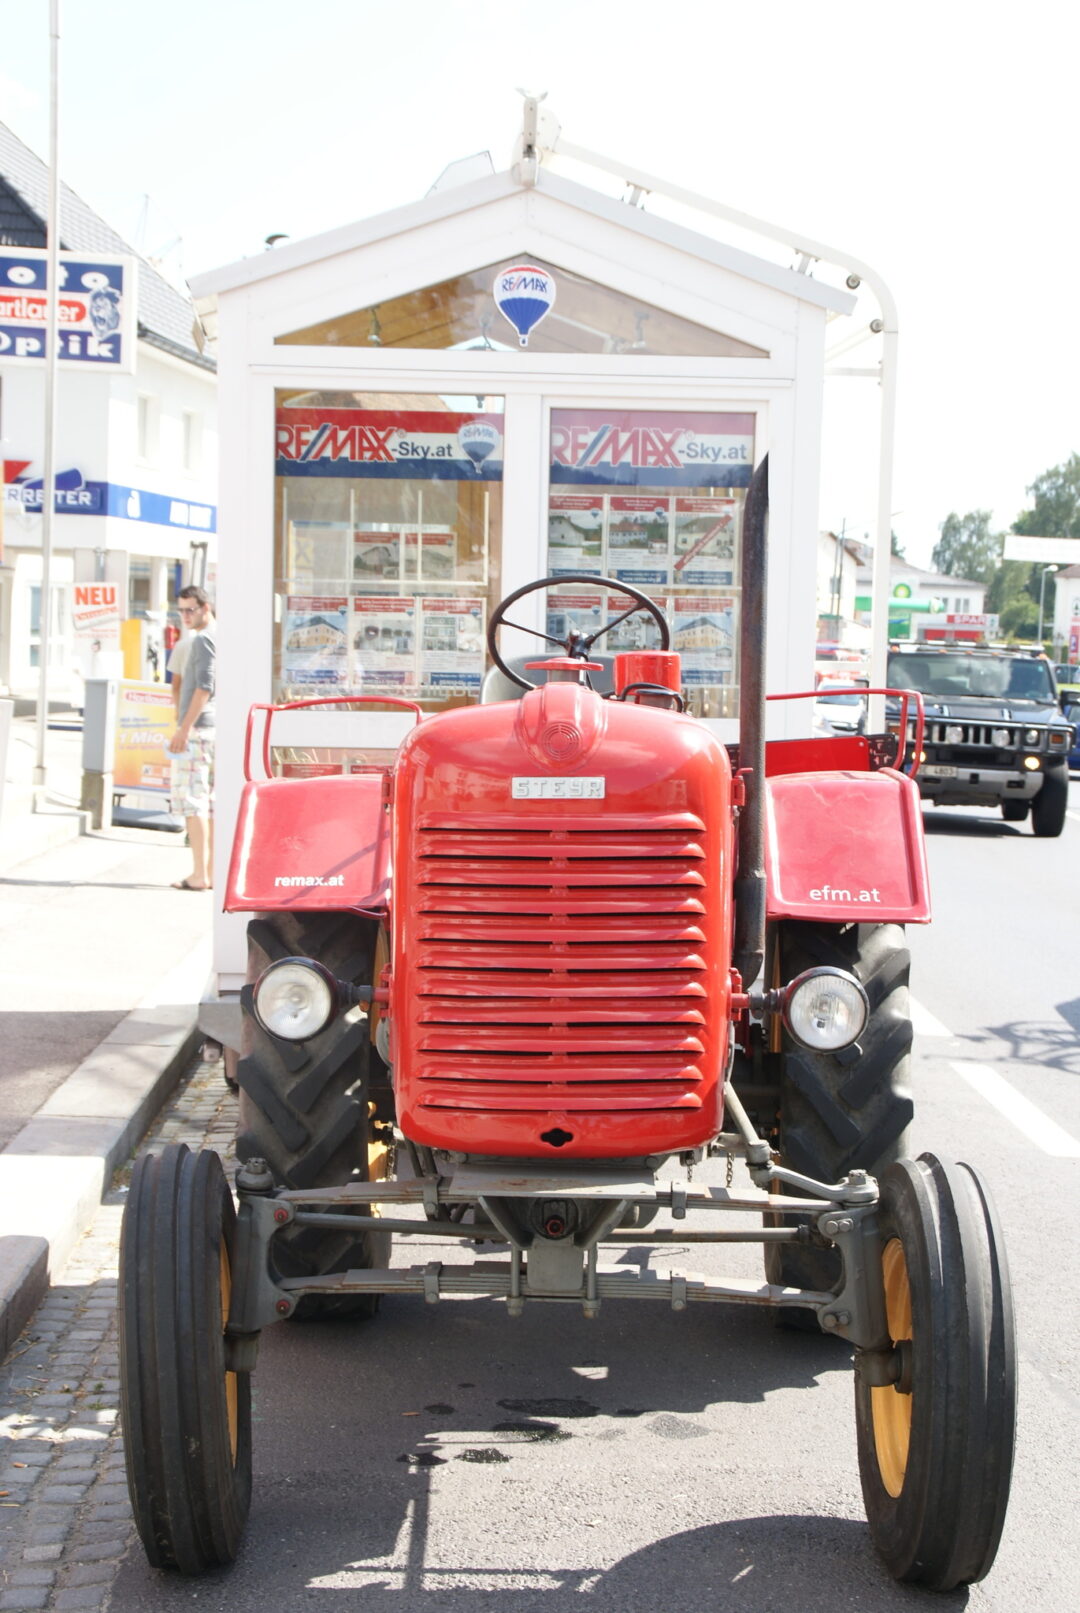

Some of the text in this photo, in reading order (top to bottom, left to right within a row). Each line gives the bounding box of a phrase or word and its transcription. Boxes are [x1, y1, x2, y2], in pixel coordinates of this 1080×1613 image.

[75, 587, 115, 605] NEU
[954, 615, 986, 624] SPAR
[516, 780, 602, 798] STEYR
[274, 874, 344, 887] remax.at
[809, 885, 880, 902] efm.at
